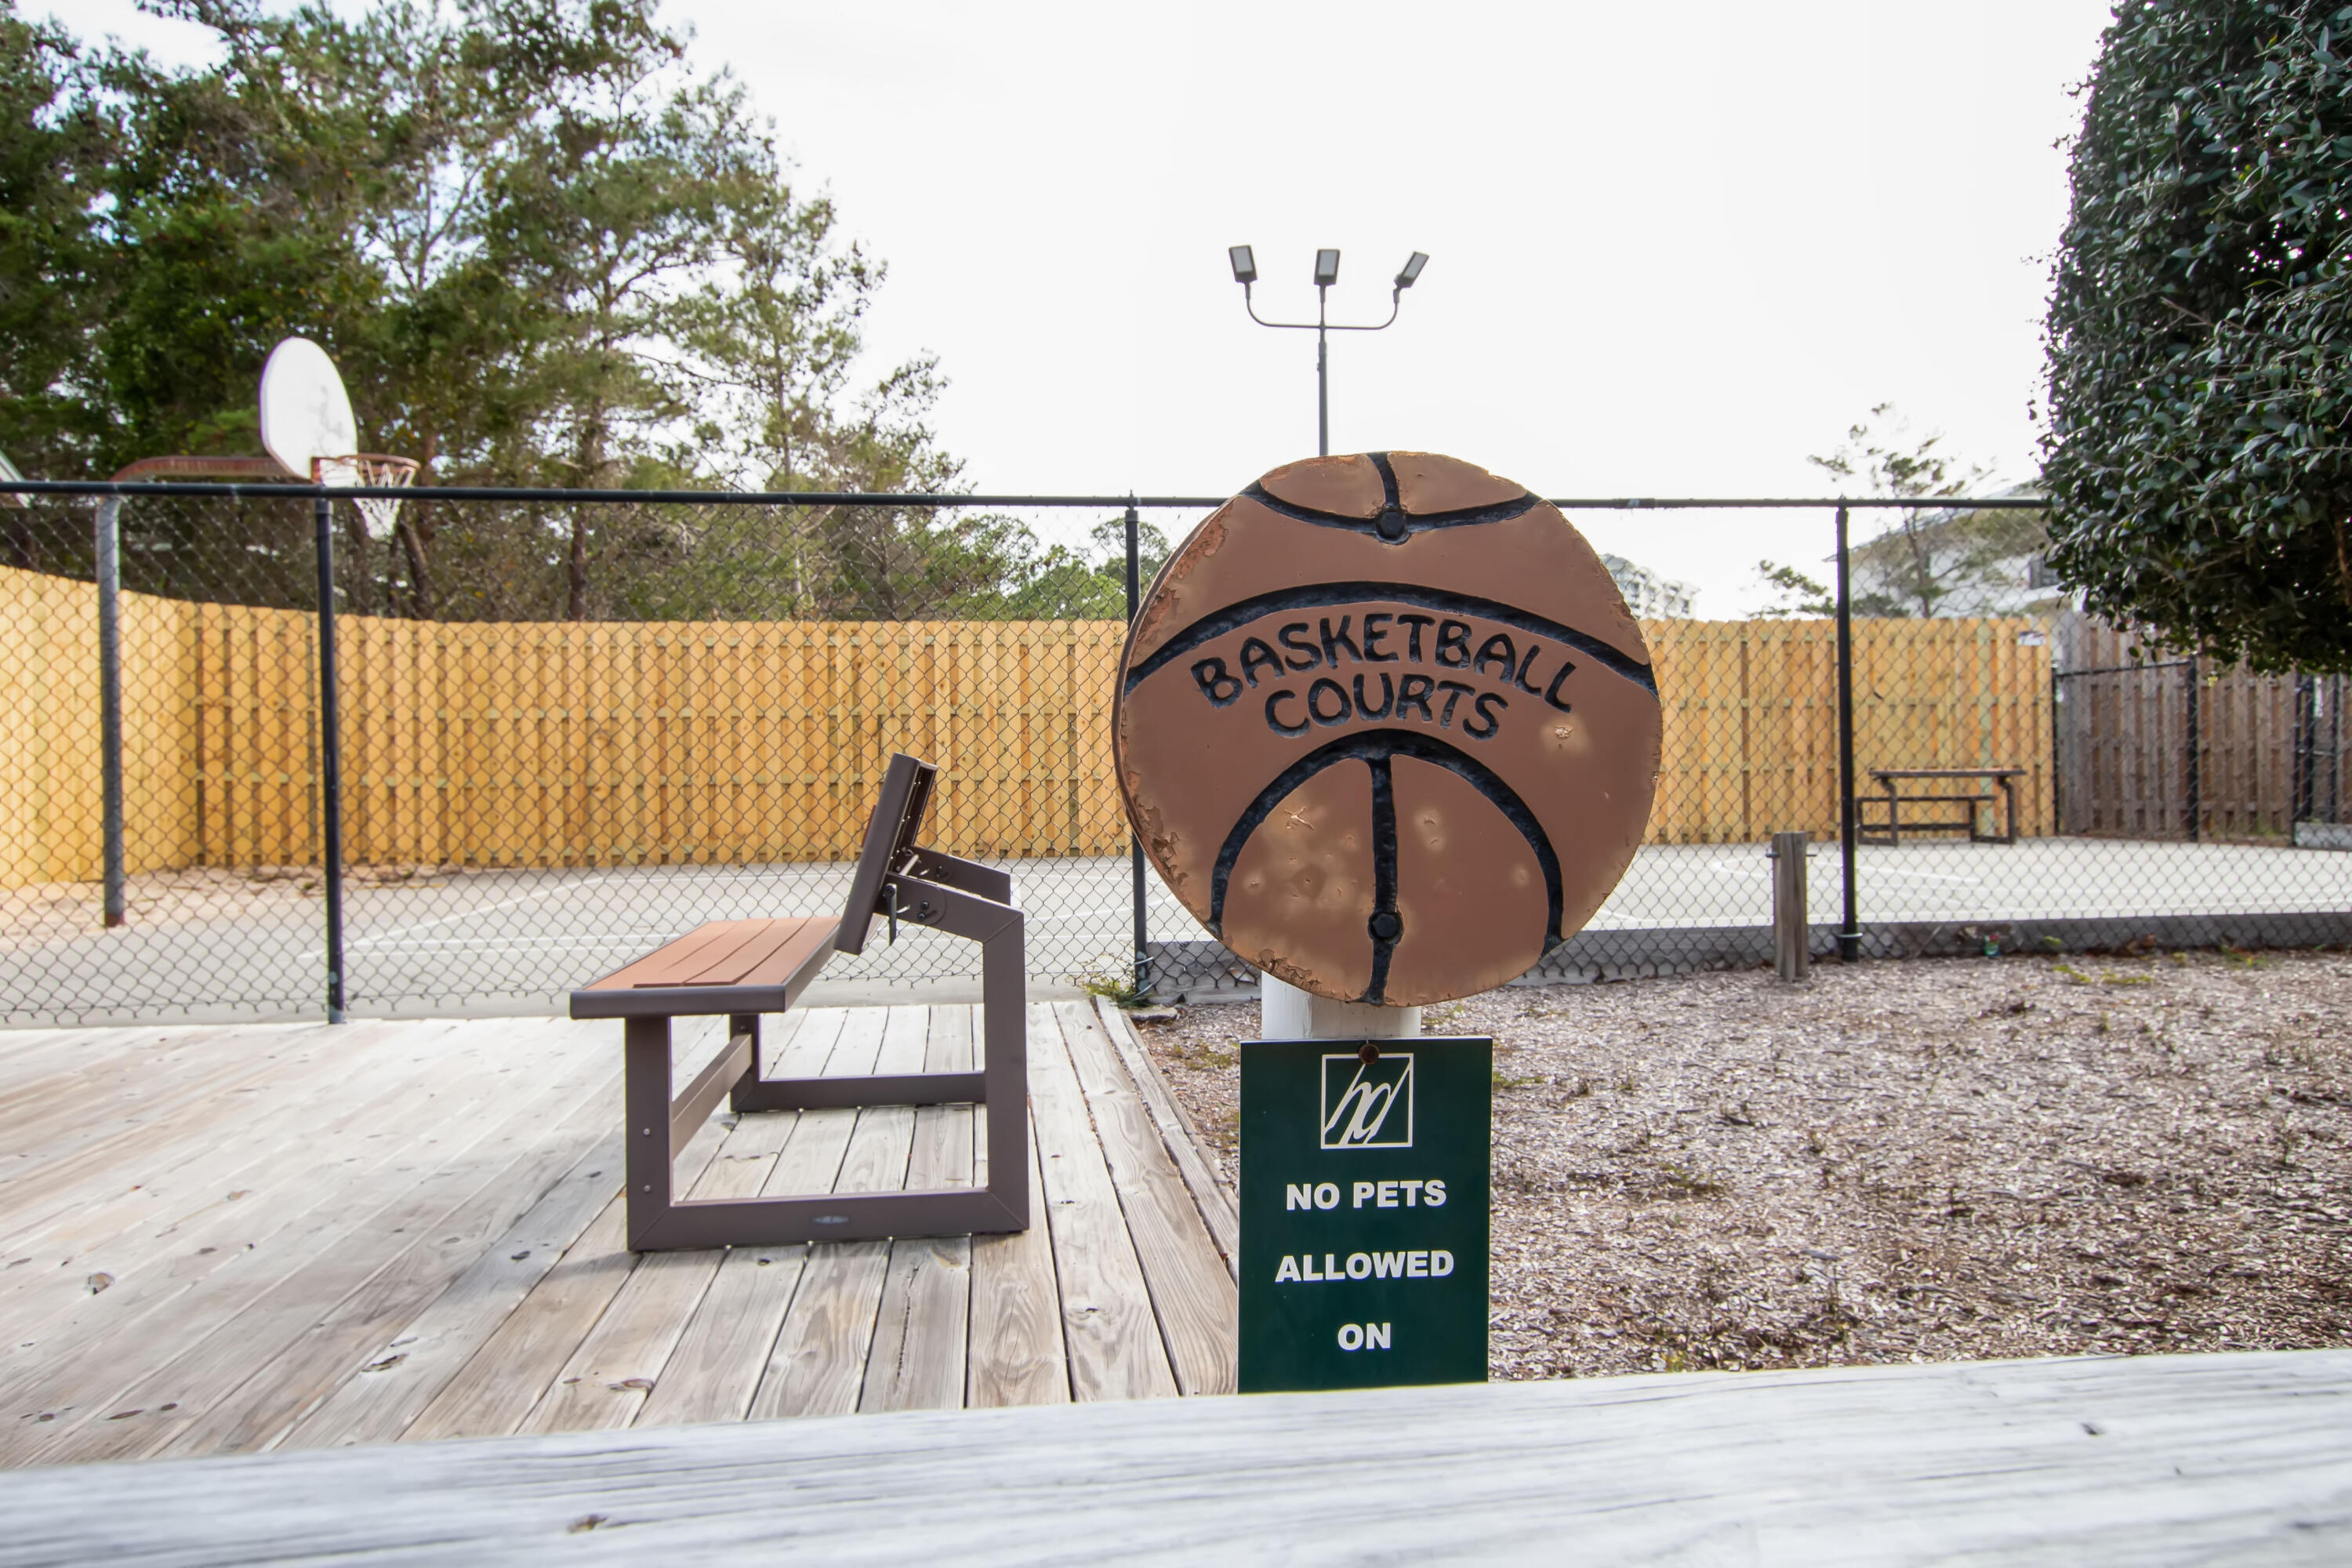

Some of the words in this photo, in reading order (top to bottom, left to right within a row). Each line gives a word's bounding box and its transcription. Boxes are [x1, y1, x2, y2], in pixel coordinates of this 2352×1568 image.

[1190, 613, 1577, 713] BASKETBALL
[1264, 673, 1508, 741] COURTS
[1287, 1183, 1340, 1210] NO
[1353, 1180, 1446, 1208] PETS
[1275, 1250, 1454, 1283] ALLOWED
[1338, 1323, 1392, 1351] ON
